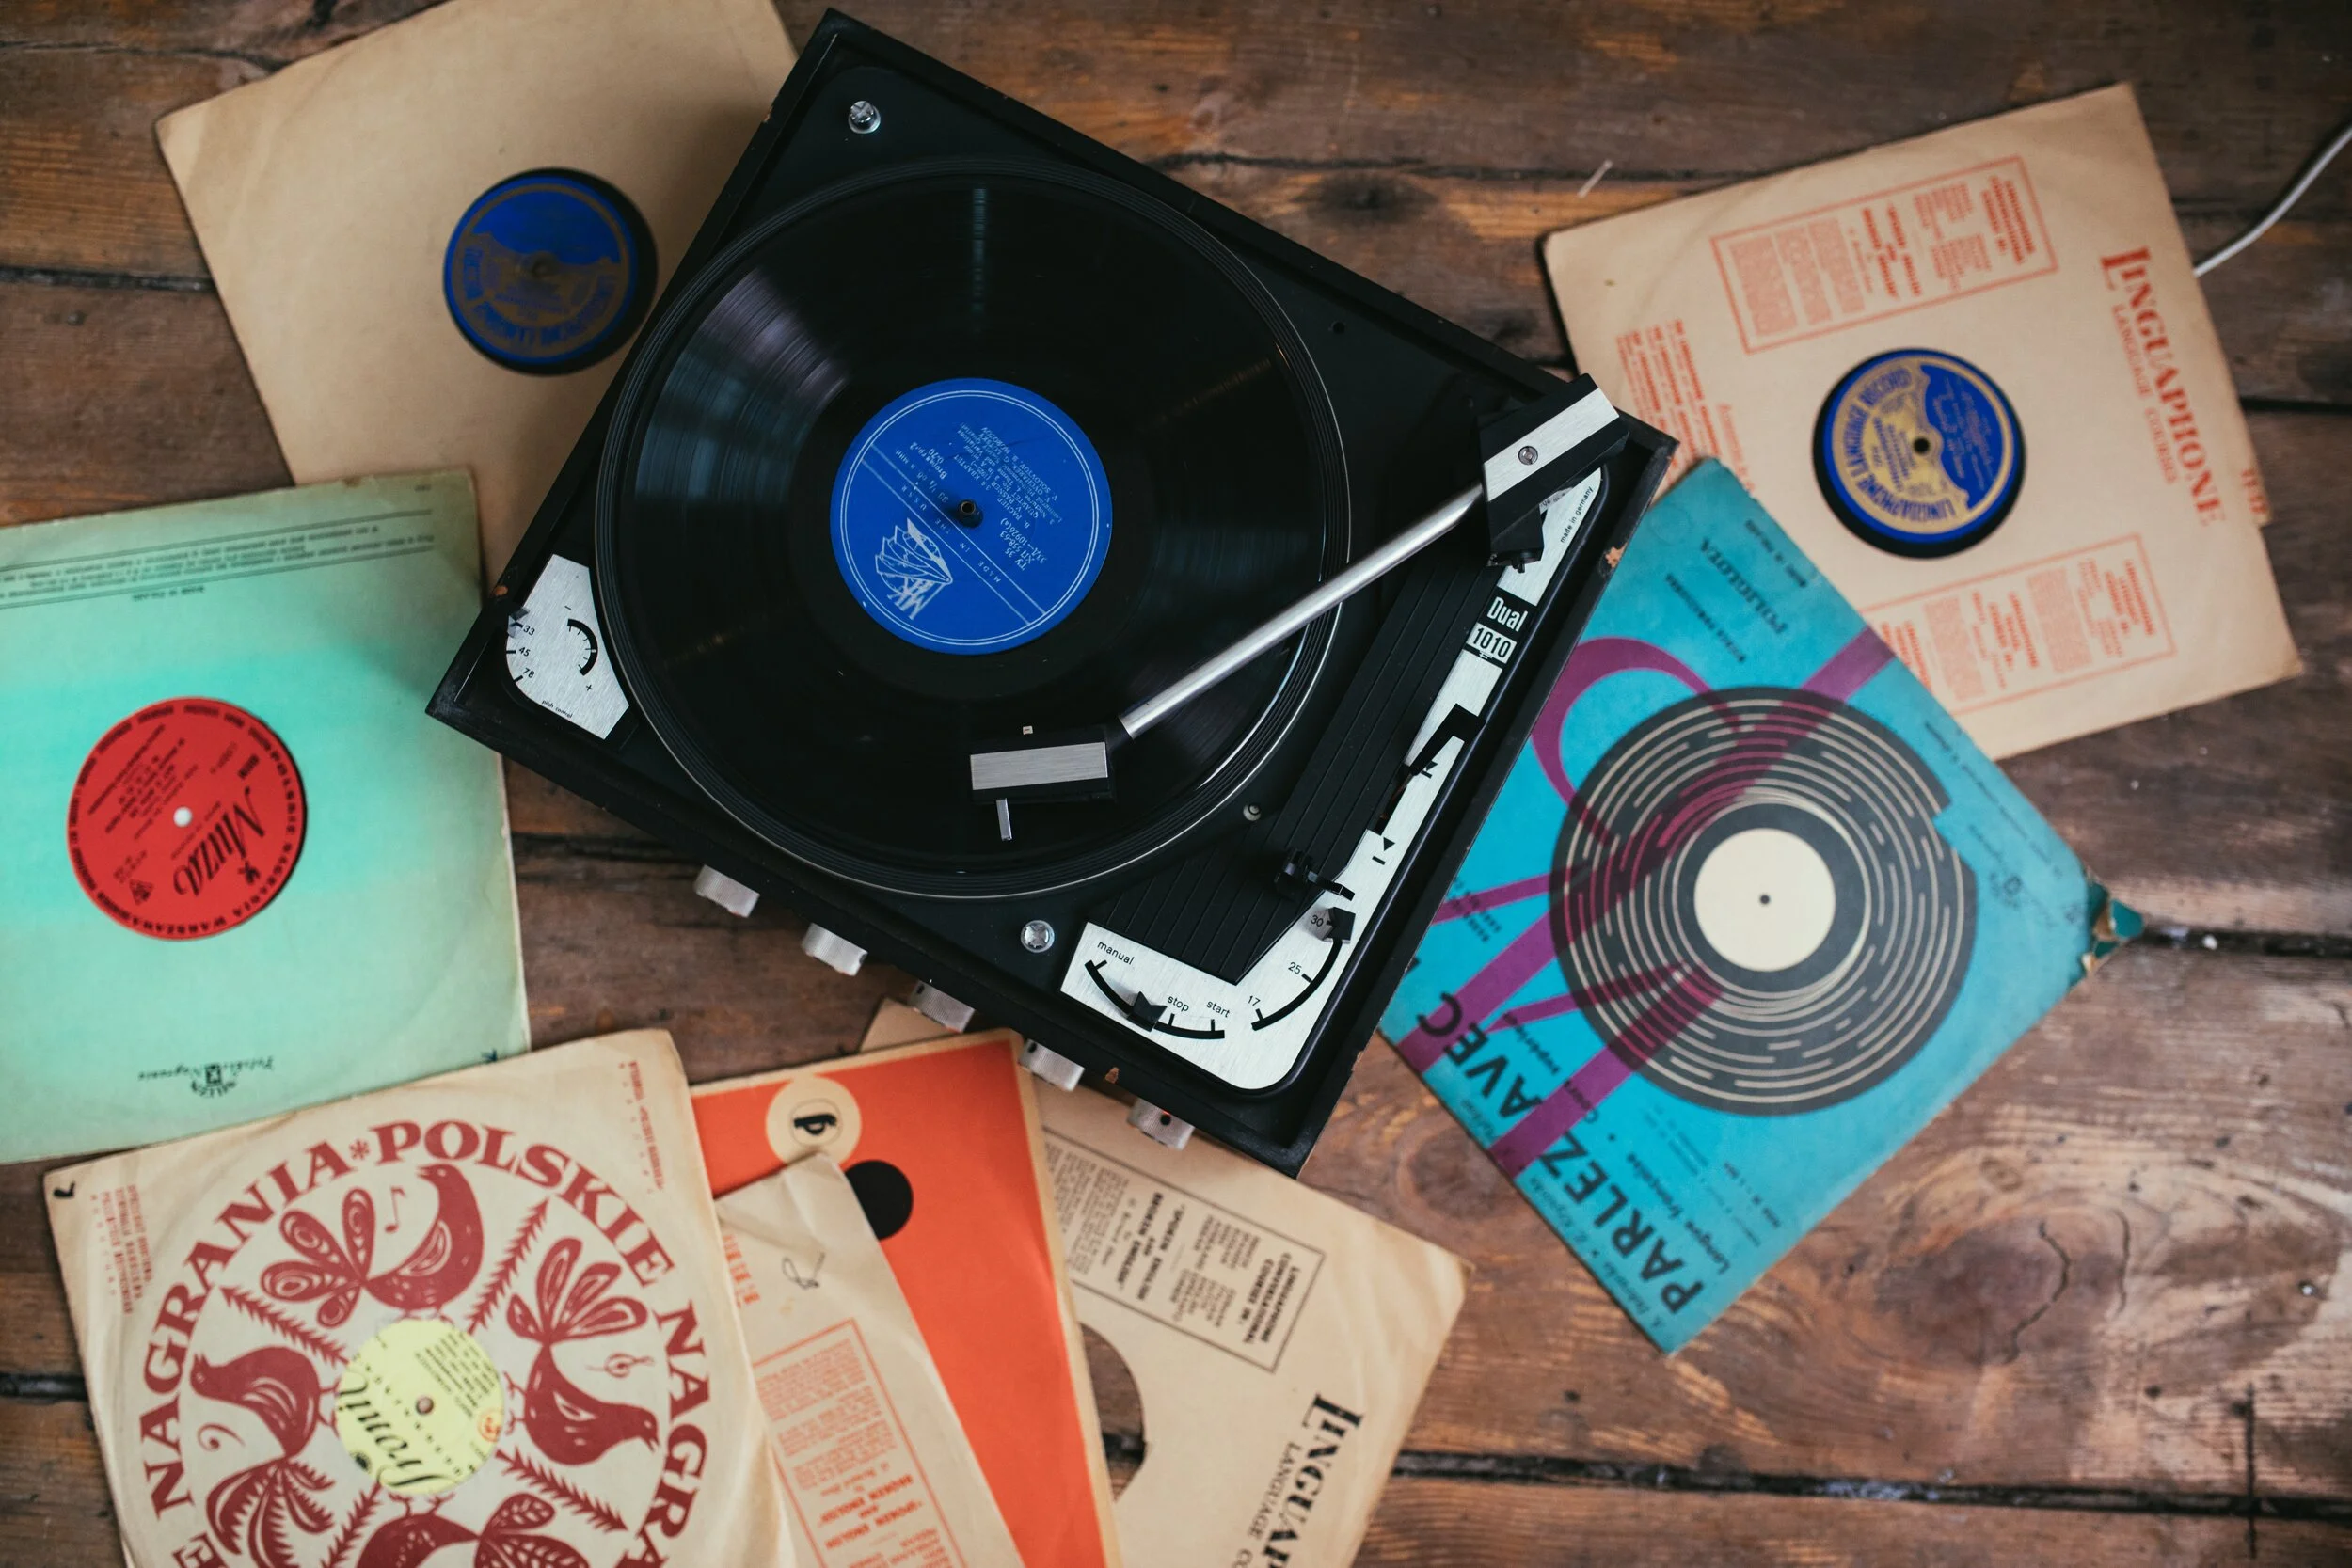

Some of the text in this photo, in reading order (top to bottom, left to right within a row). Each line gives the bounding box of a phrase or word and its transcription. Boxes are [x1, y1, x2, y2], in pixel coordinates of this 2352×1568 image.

[2112, 304, 2152, 400] LANGUAGE
[2101, 245, 2228, 529] LINGUAPHONE
[934, 517, 951, 534] THE
[1560, 524, 1573, 543] made
[1575, 486, 1594, 515] germany
[958, 541, 970, 552] IN
[1004, 546, 1015, 558] 35
[977, 560, 1001, 583] MADE
[1486, 595, 1529, 633] Dual
[523, 625, 535, 636] 33
[1473, 626, 1511, 658] 1010
[519, 647, 530, 657] 45
[523, 668, 534, 678] 78
[542, 699, 573, 719] pitch control
[172, 785, 264, 897] Muza
[1310, 914, 1325, 927] 30
[1097, 940, 1135, 966] manual
[1288, 961, 1302, 975] 25
[1167, 995, 1231, 1018] stop start
[1248, 995, 1261, 1006] 17
[1411, 988, 1545, 1132] AVEC
[1557, 1076, 1602, 1125] Cours
[1533, 1127, 1708, 1318] PARLEZ
[1677, 1213, 1737, 1277] Langue
[139, 1139, 361, 1521] NAGRANIA
[371, 1118, 675, 1288] POLSKIE
[1247, 1441, 1303, 1541] LANGUAGE
